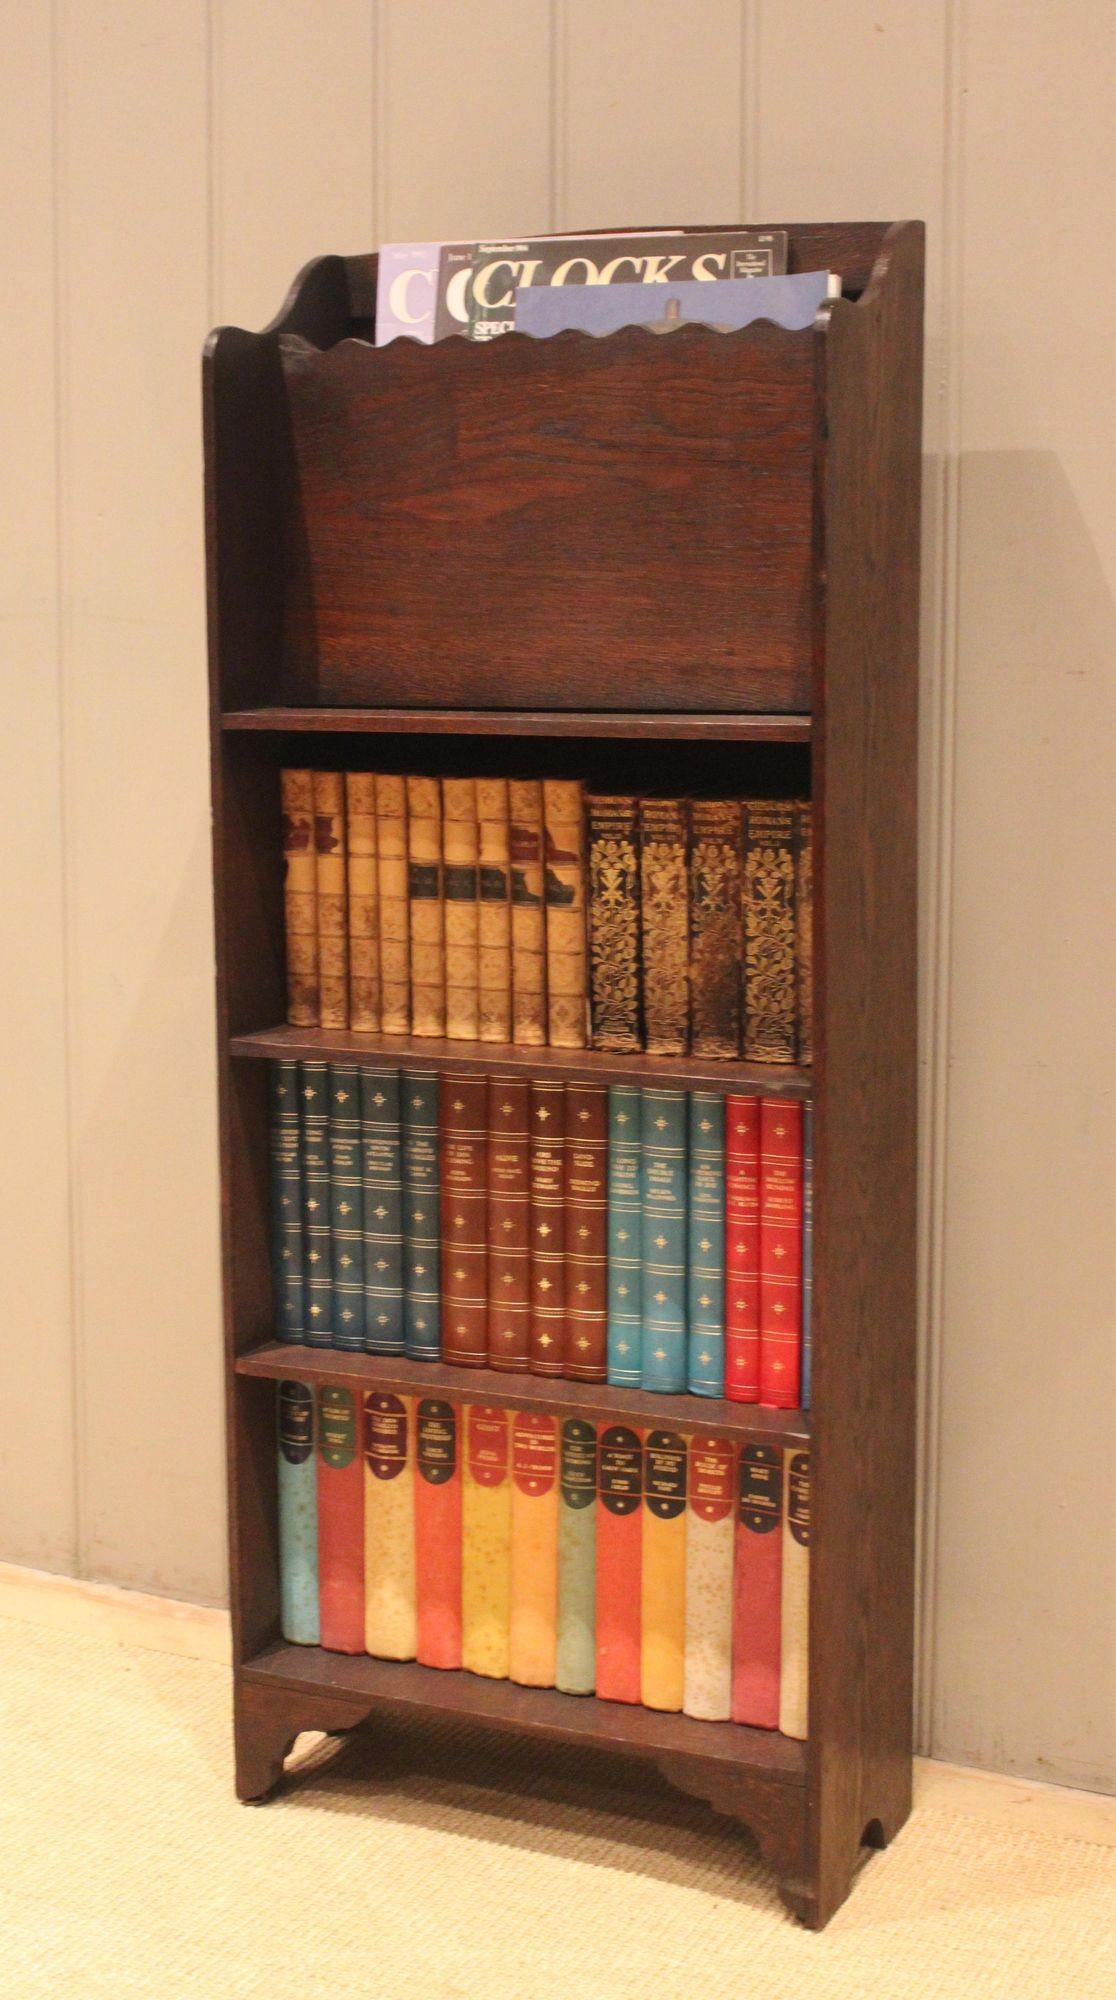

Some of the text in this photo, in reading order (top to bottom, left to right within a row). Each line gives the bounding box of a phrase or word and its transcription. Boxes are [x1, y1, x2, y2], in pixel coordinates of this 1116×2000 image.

[389, 268, 438, 323] C
[472, 252, 727, 308] CLOCKS
[474, 321, 516, 335] SPEC
